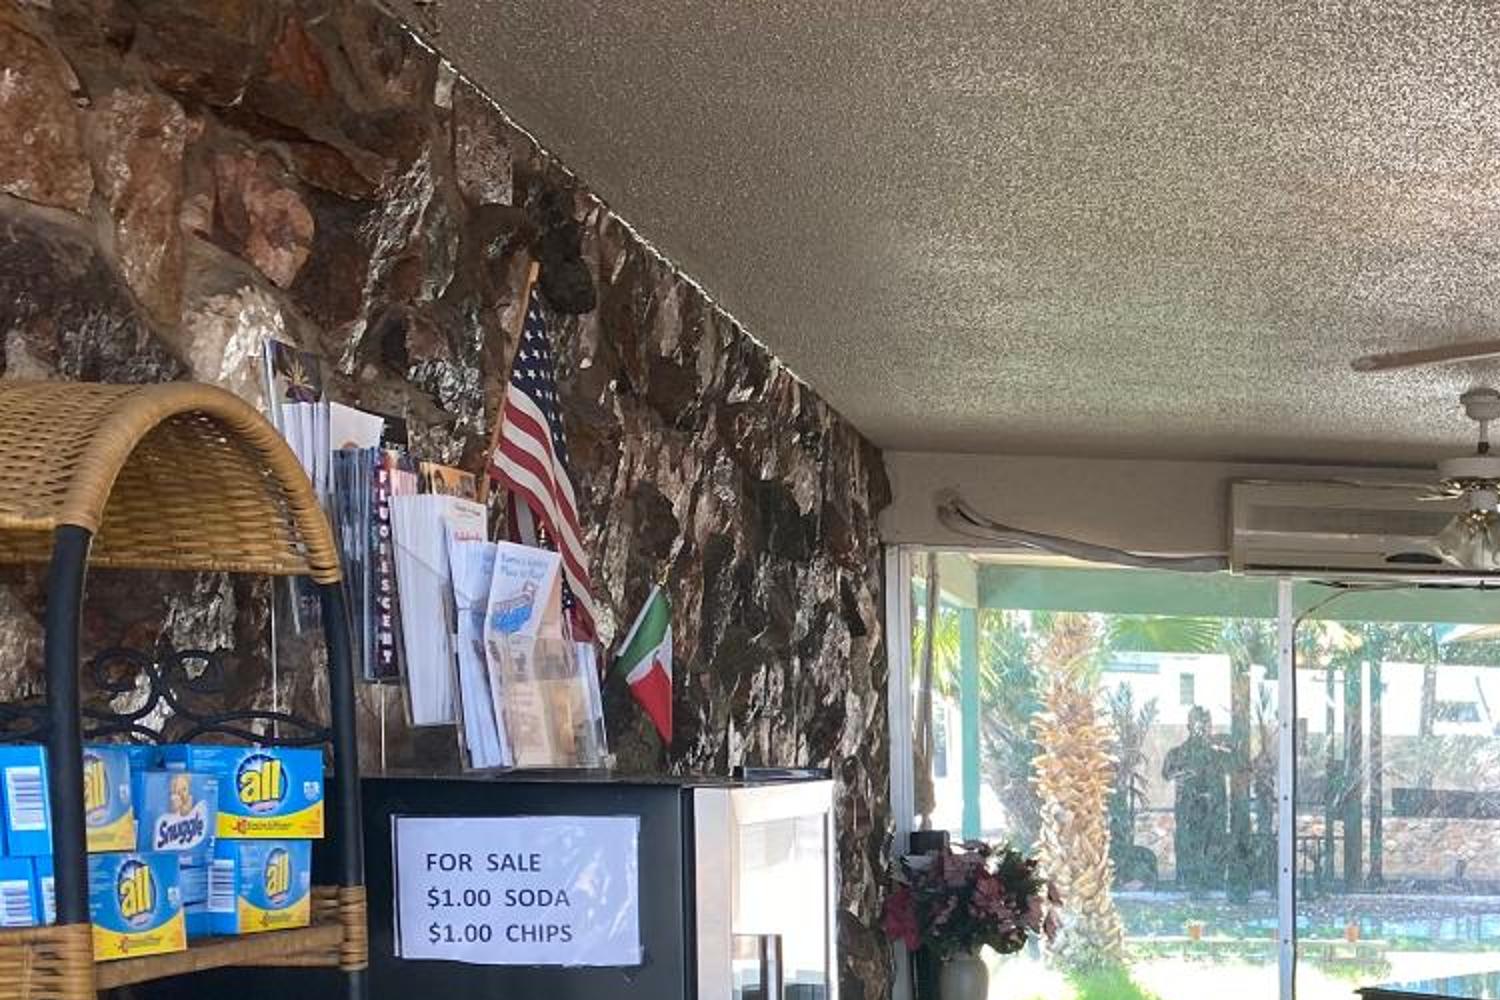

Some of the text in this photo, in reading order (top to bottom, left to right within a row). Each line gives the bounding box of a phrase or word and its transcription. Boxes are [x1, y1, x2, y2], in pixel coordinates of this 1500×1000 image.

[238, 758, 281, 804] all
[157, 813, 204, 849] Snuggle
[264, 855, 290, 898] all
[426, 852, 542, 872] FOR SALE
[120, 865, 150, 918] all
[427, 887, 571, 909] $1.00 SODA
[428, 922, 573, 944] $1.00 CHIPS
